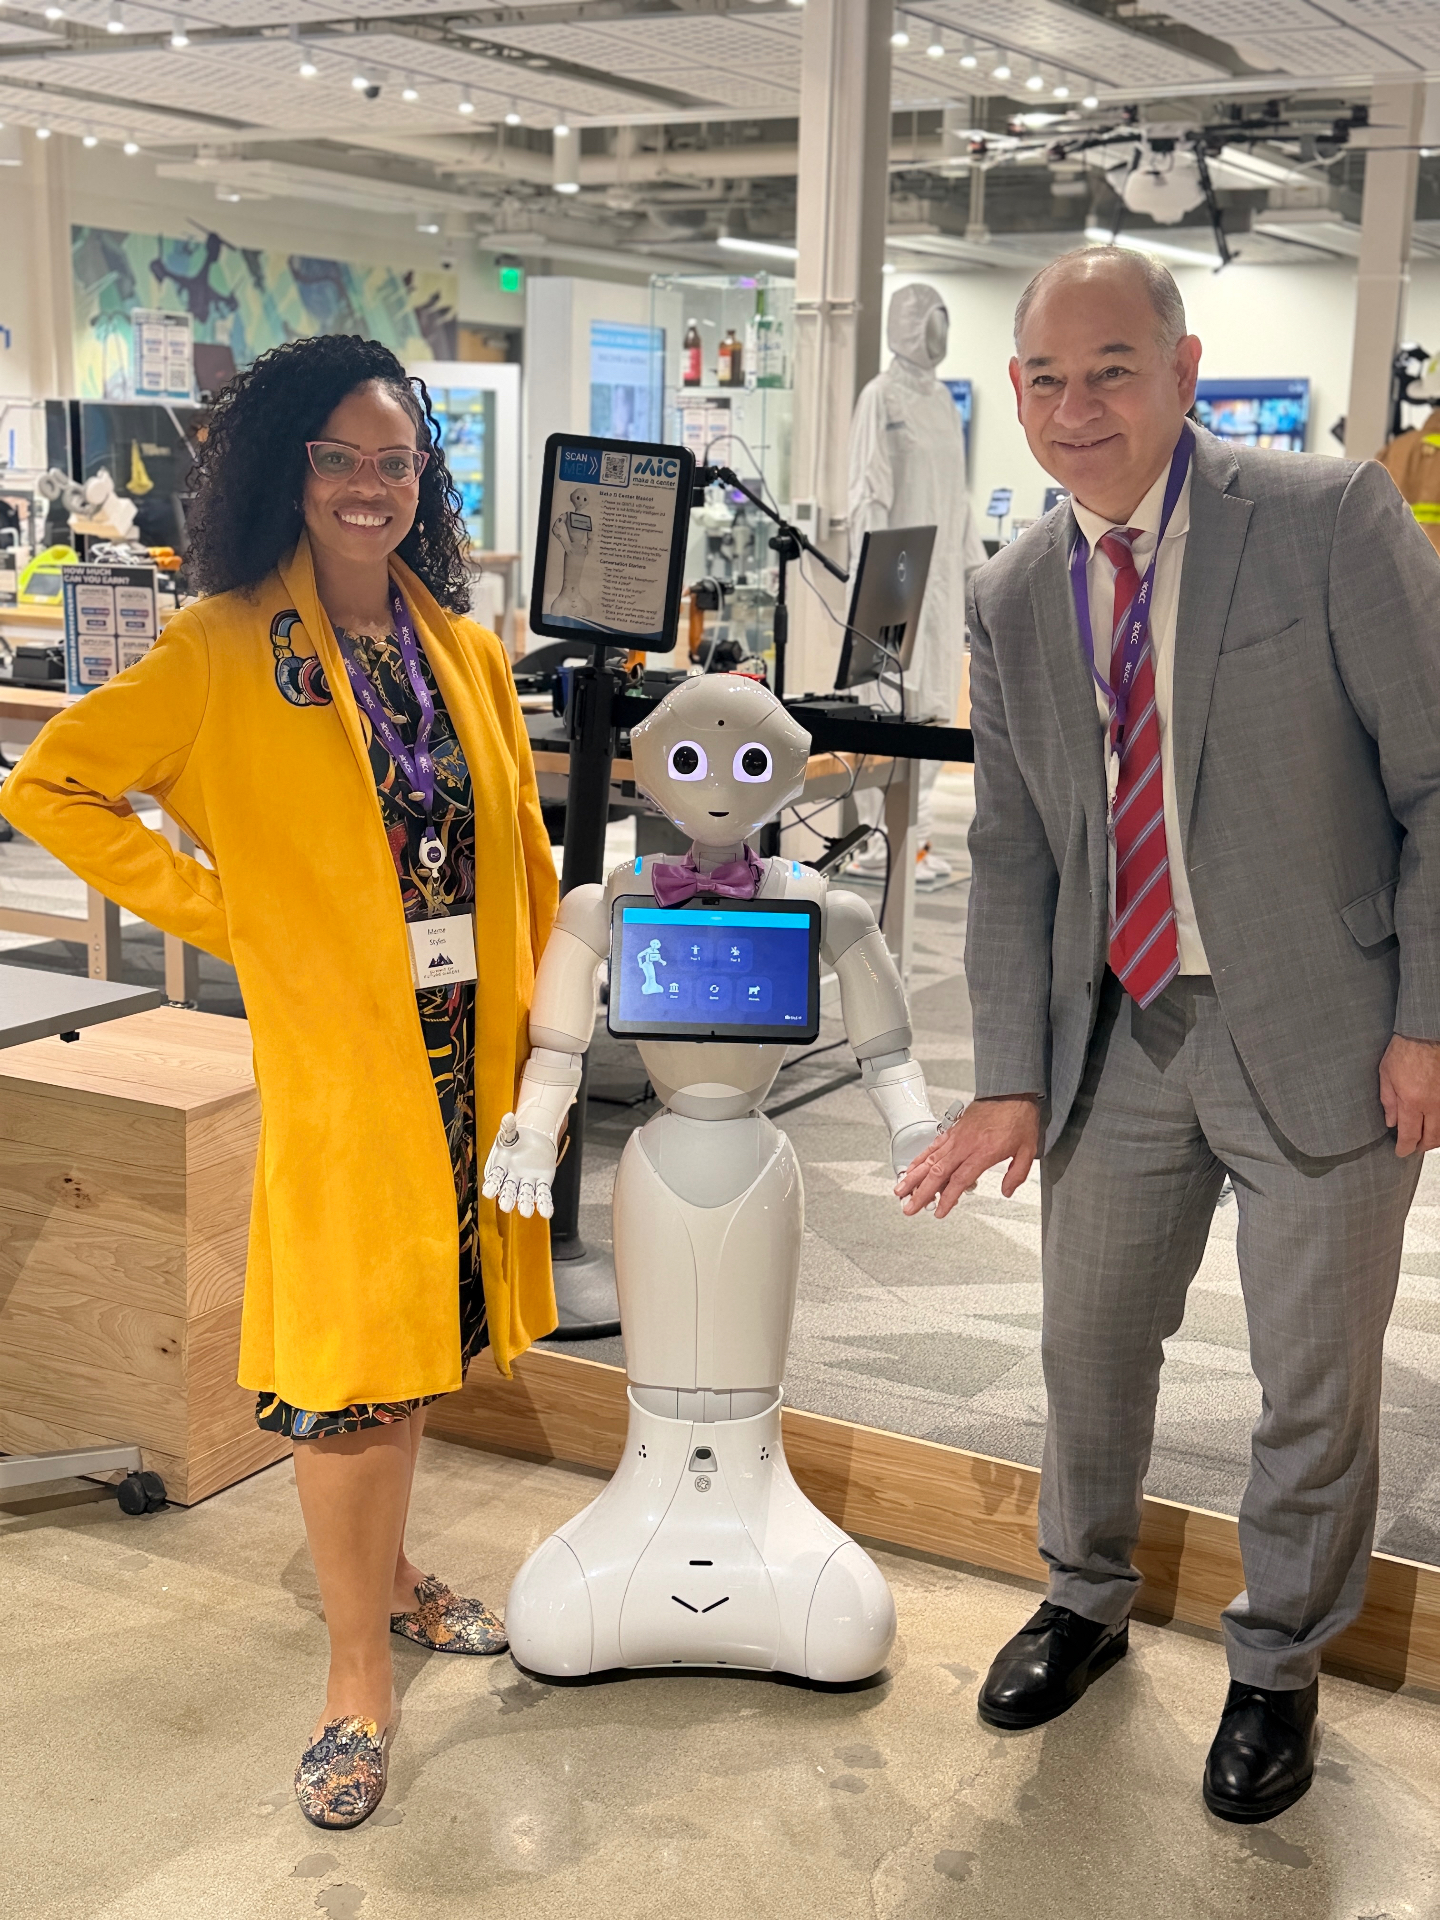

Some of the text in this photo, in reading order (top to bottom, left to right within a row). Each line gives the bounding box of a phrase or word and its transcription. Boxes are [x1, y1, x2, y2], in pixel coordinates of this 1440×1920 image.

[566, 452, 588, 462] SCAN
[564, 462, 586, 476] ME!
[86, 568, 111, 576] MUCH
[102, 576, 130, 585] EARN?
